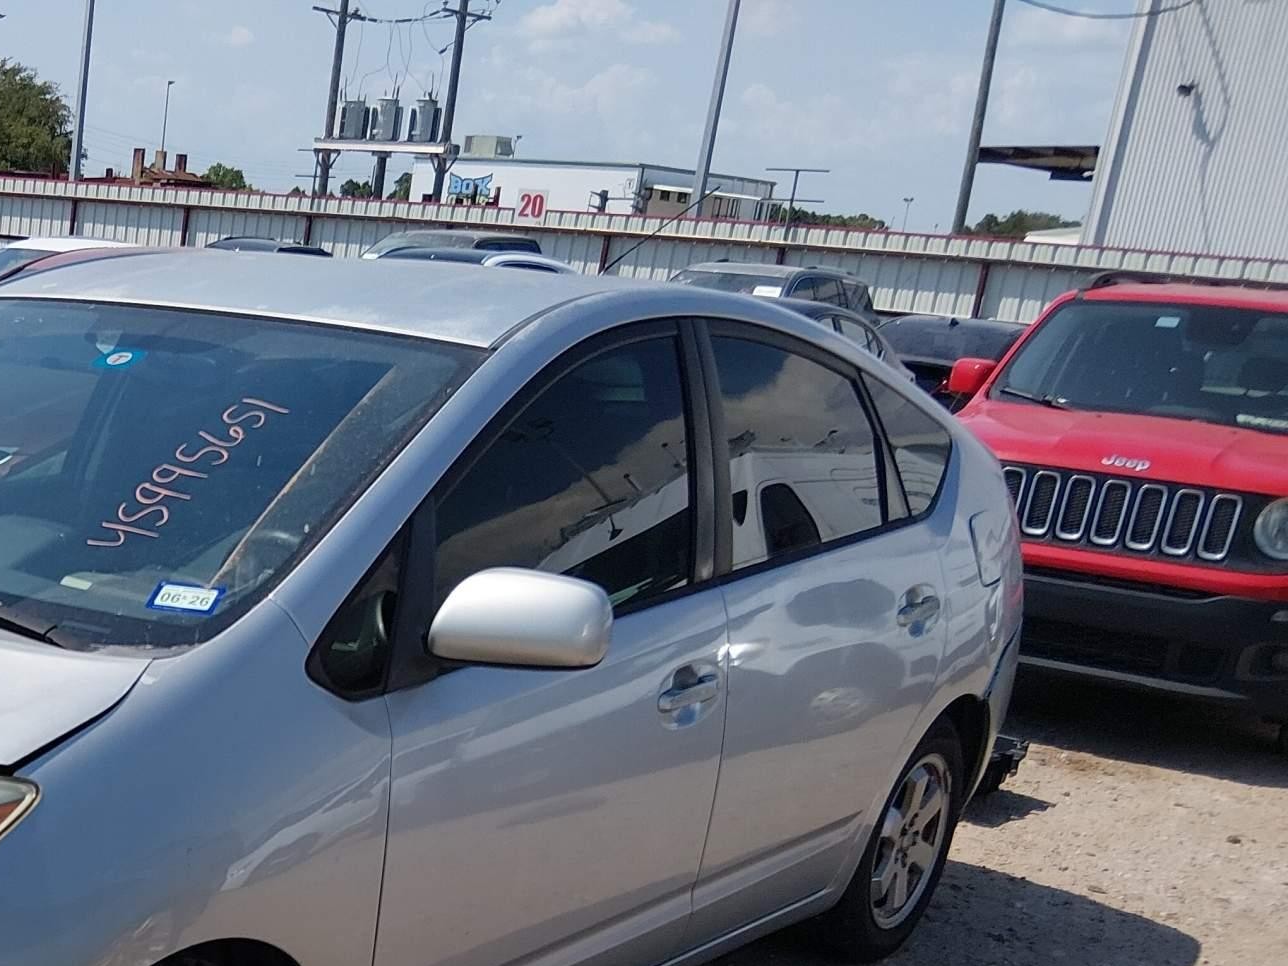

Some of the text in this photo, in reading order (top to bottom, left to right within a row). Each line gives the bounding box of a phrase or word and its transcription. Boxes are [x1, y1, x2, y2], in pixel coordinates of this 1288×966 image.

[518, 193, 545, 218] 20
[87, 398, 289, 547] 45995651
[1101, 455, 1151, 472] Jeep
